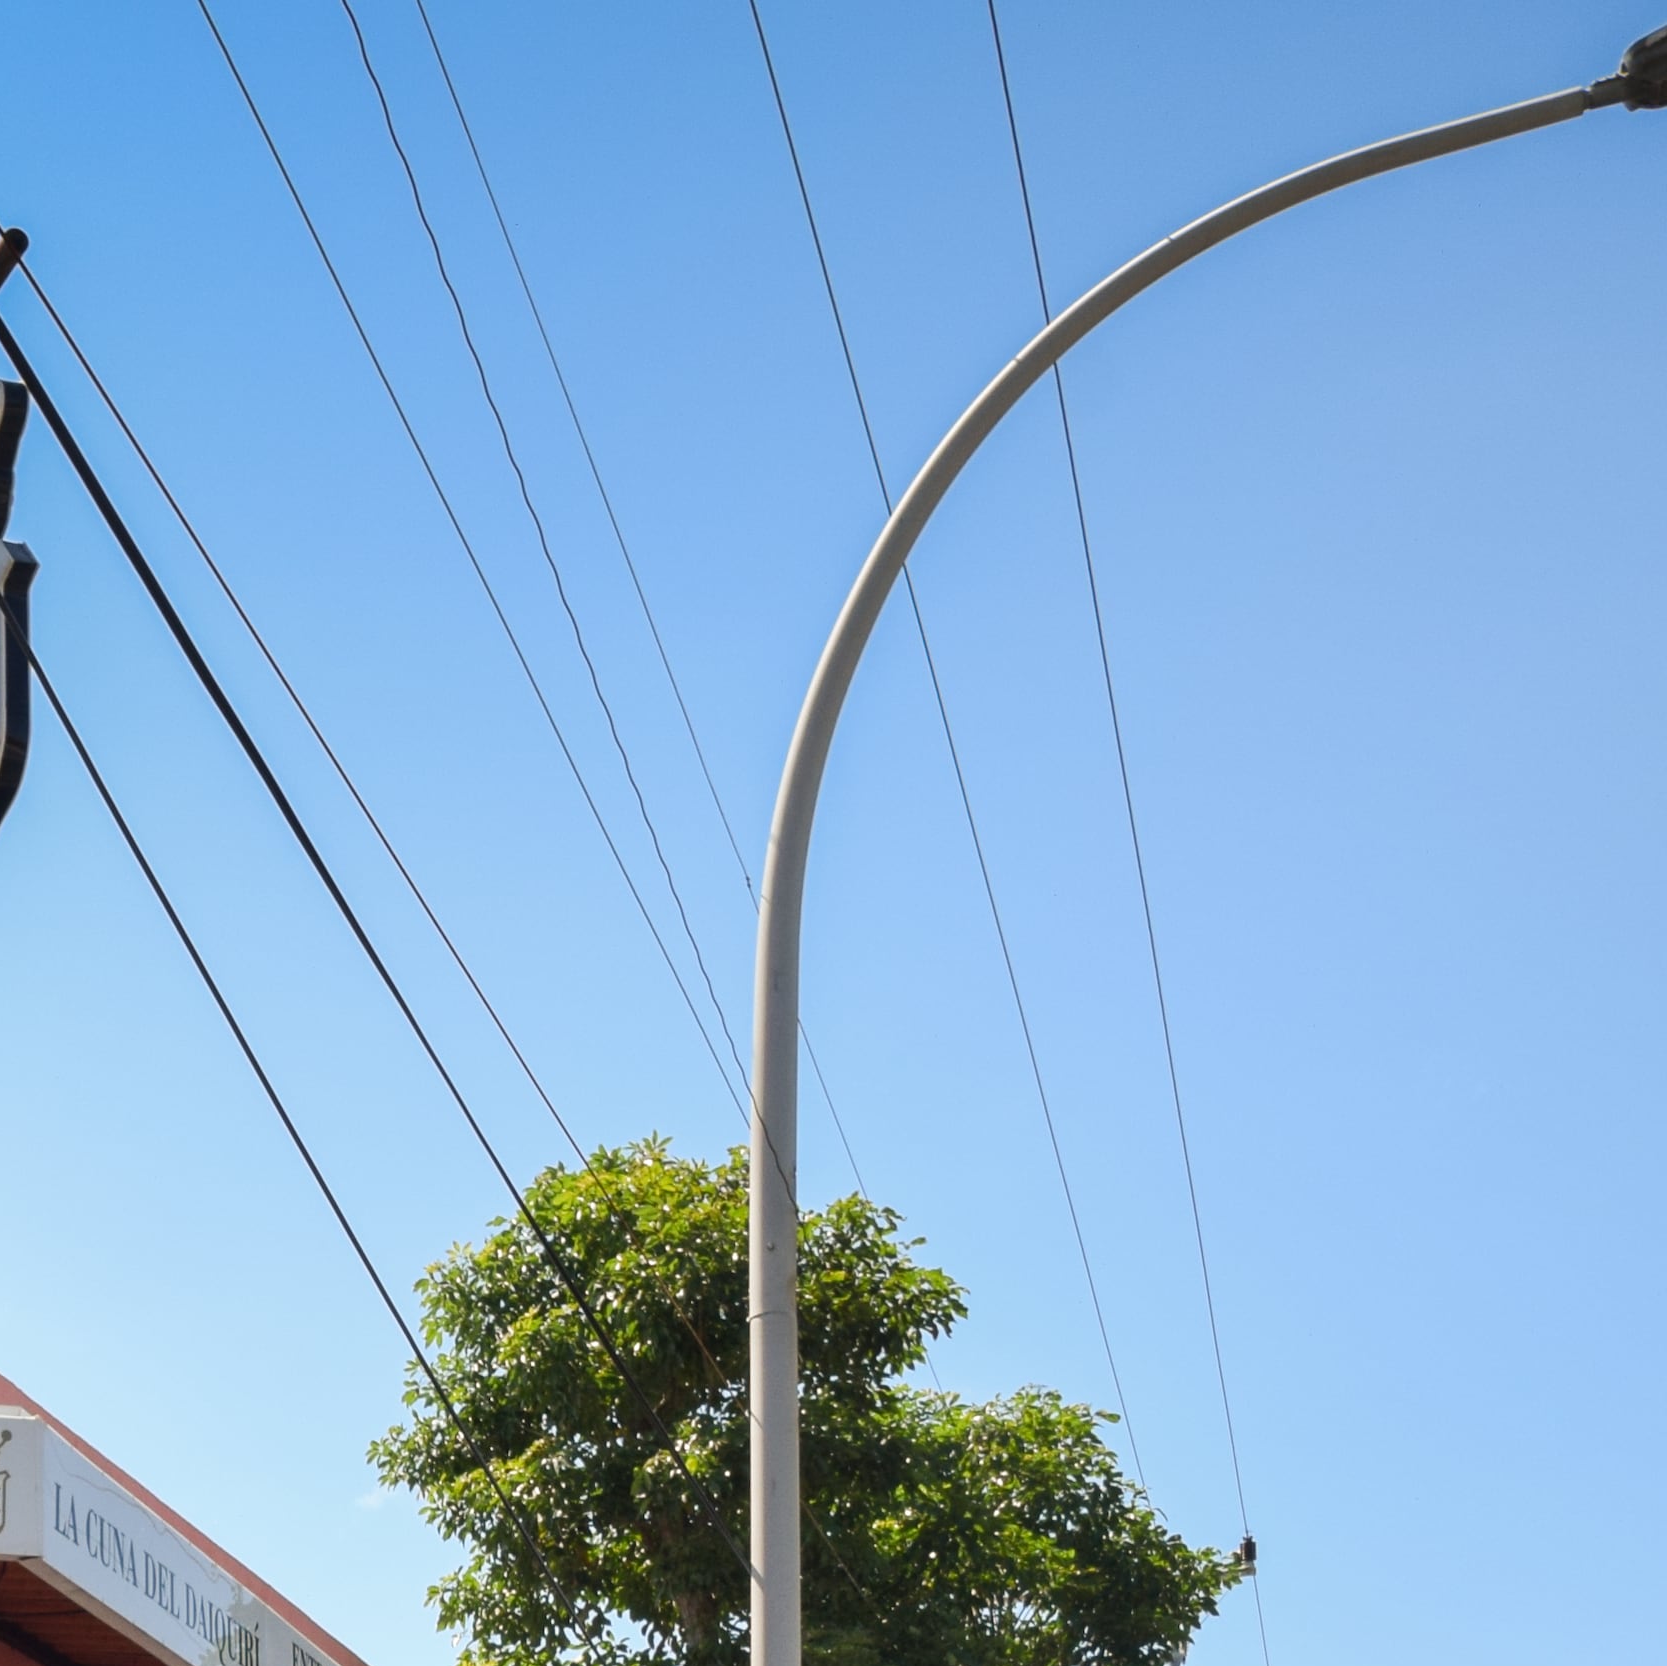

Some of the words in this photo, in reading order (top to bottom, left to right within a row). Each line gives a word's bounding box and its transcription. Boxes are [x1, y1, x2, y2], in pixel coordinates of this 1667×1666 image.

[53, 1482, 80, 1546] LA
[85, 1508, 139, 1589] CUNA
[144, 1550, 180, 1620] DEL
